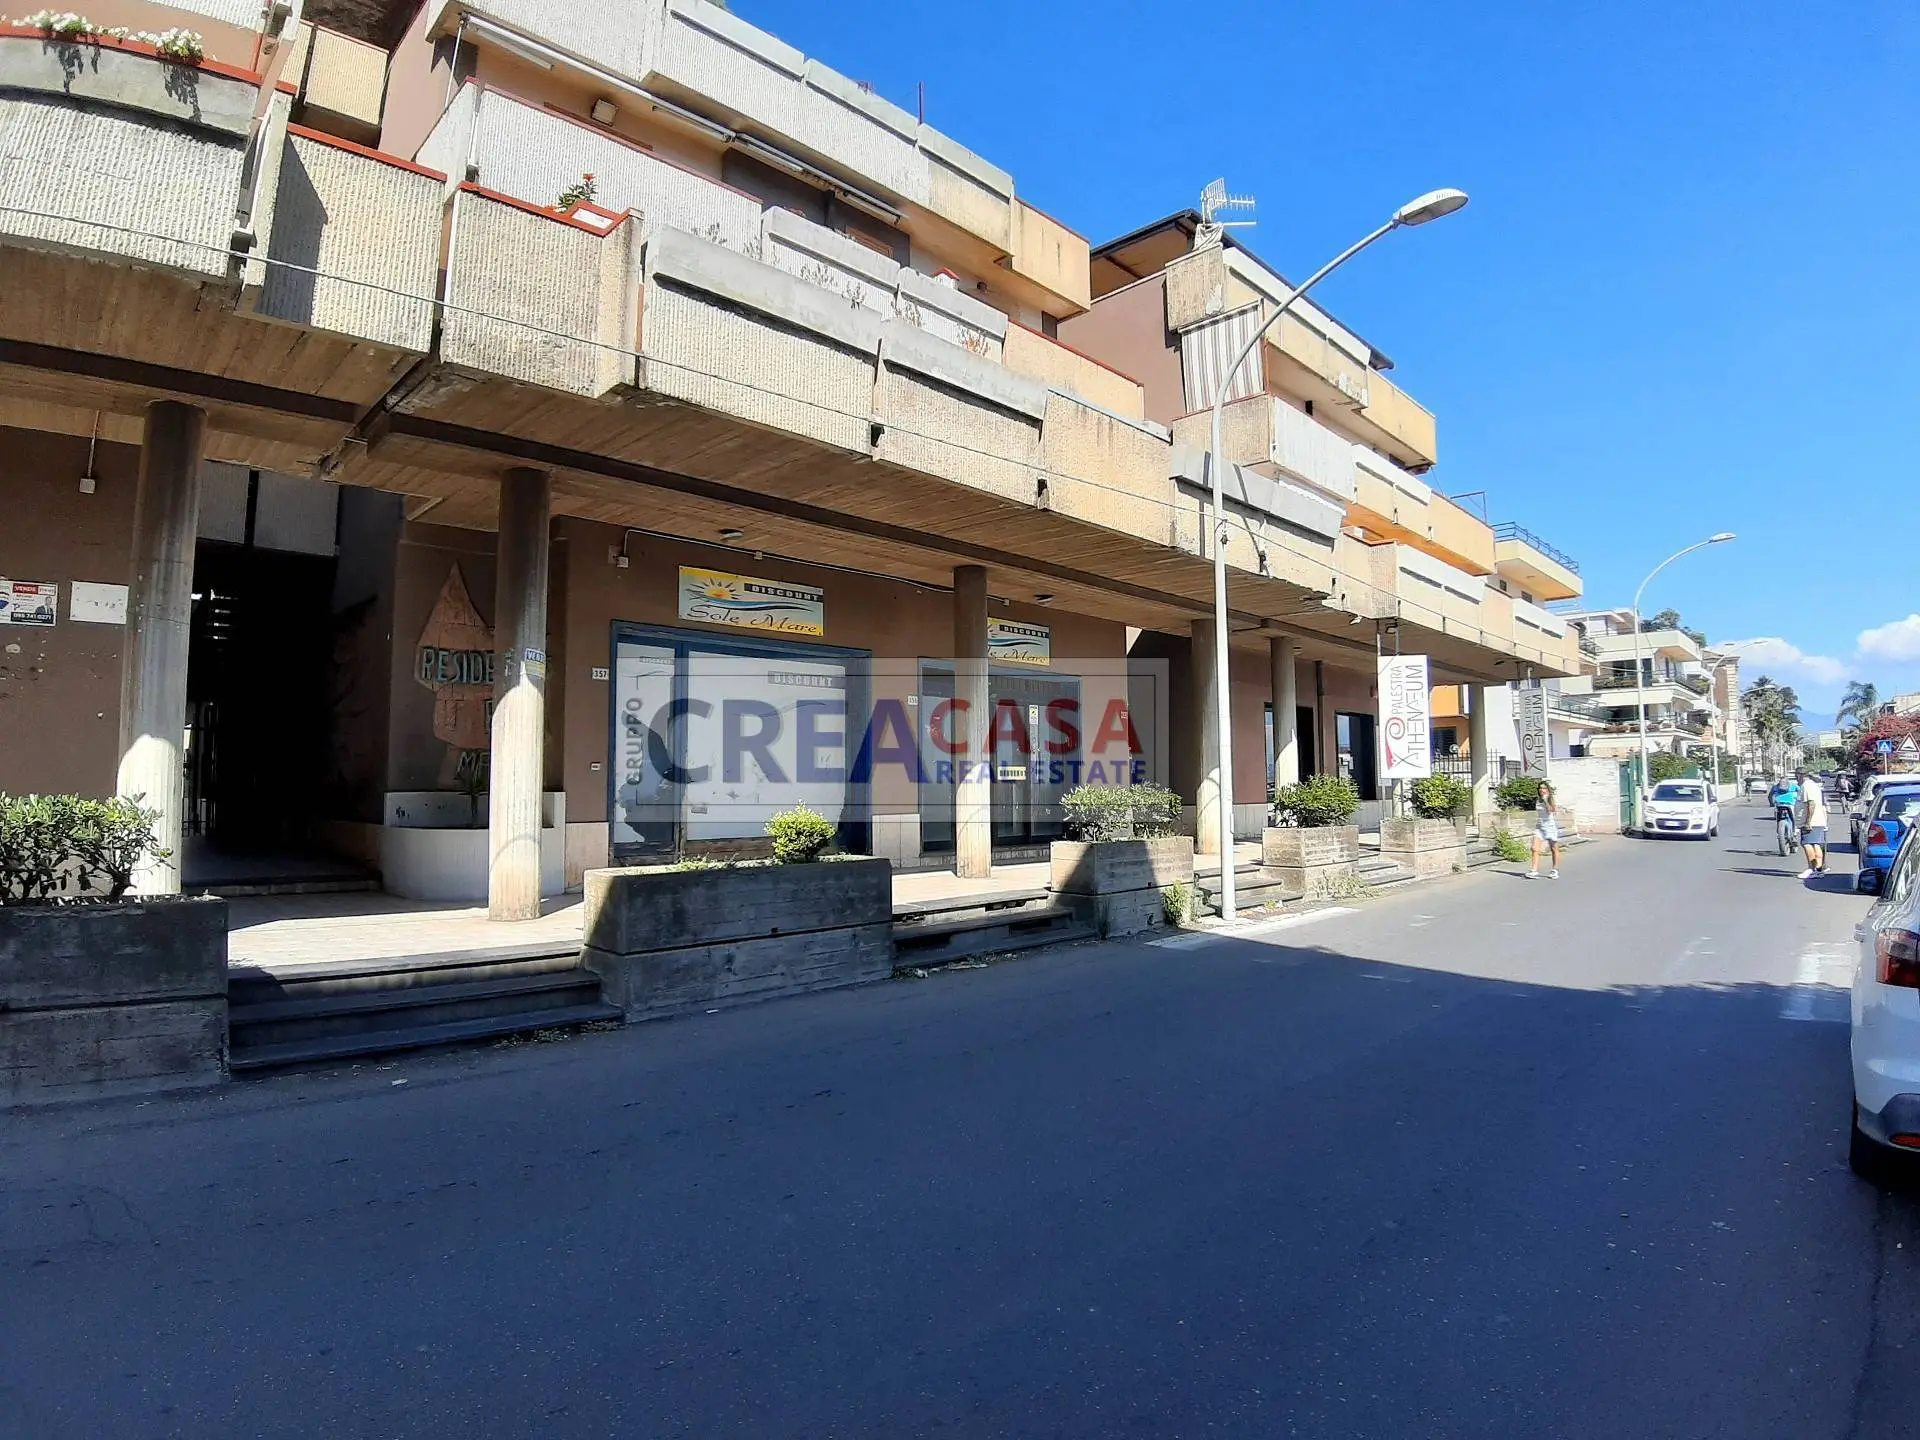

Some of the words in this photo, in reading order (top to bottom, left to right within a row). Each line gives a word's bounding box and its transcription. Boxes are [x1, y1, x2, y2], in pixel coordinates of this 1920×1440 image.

[751, 585, 819, 601] DISCOUNT
[687, 605, 739, 622] Sole
[750, 613, 817, 633] Mare
[1004, 627, 1047, 638] DISCOUNT
[594, 670, 607, 678] 357
[1390, 664, 1403, 715] PALESTRA
